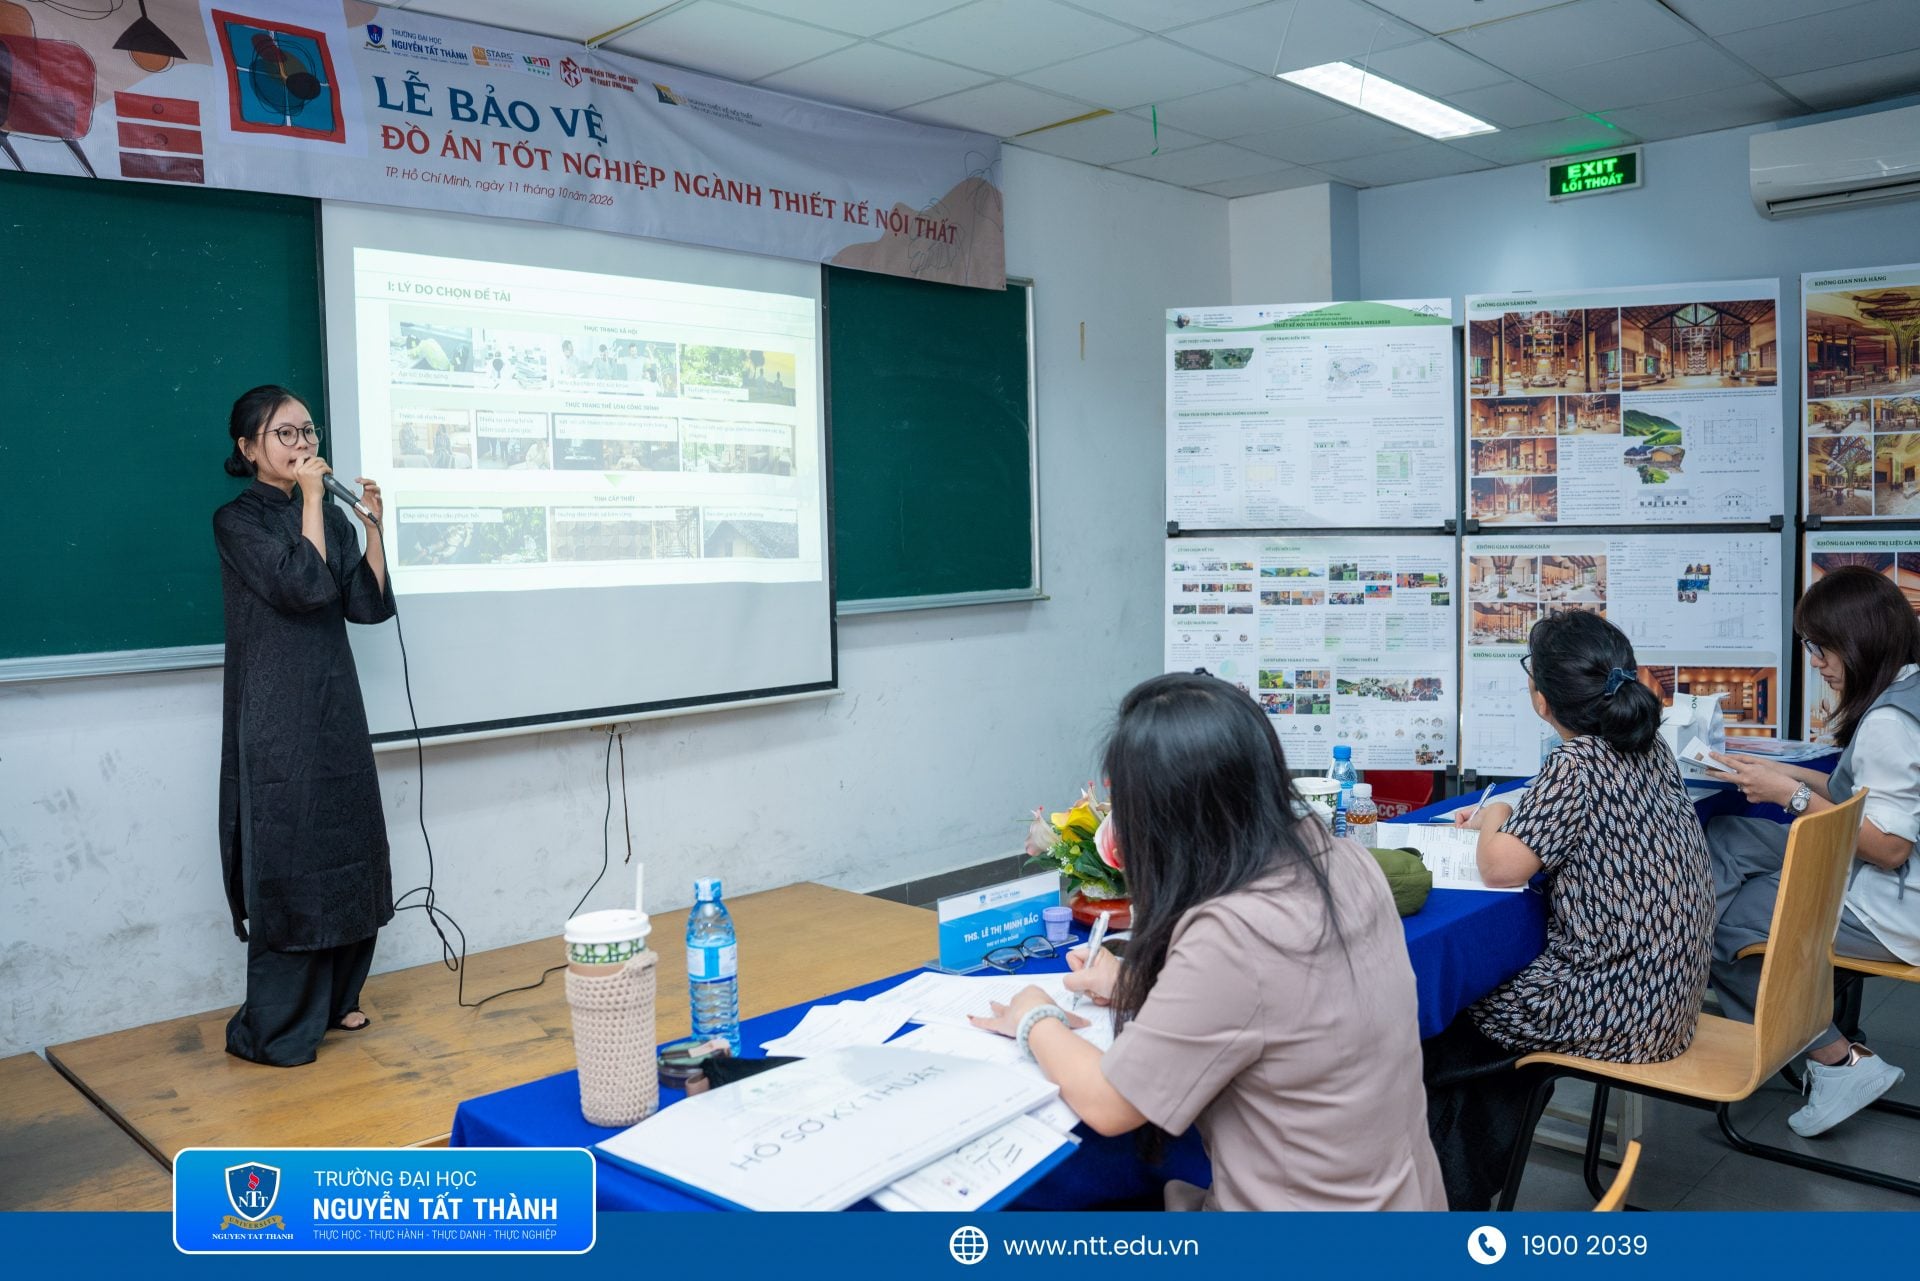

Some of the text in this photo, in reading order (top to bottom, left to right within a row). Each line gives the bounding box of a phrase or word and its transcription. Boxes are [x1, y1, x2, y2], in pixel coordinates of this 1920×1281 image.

[391, 39, 423, 53] NGUYỄN
[425, 44, 439, 56] TẤT
[440, 48, 468, 60] THÀNH
[429, 37, 442, 45] HỌC
[371, 70, 608, 147] LỄ BẢO VỆ
[1567, 158, 1618, 179] EXIT
[380, 121, 957, 245] ĐỒ ÁN TỐT NGHIỆP NGÀNH THIẾT KẾ NỘI THẤT
[386, 166, 399, 179] TP.
[402, 167, 418, 181] Hồ
[421, 171, 441, 185] Chí
[443, 174, 471, 188] Minh,
[476, 179, 505, 194] ngày
[509, 181, 520, 193] 11
[523, 183, 555, 200] tháng
[1562, 172, 1624, 193] LỐI THOÁT
[398, 280, 411, 293] LÝ
[415, 284, 433, 295] DO
[436, 286, 471, 300] CHỌN
[492, 291, 511, 302] TÀI
[964, 912, 1039, 943] THS. LÊ THỊ MINH BẮC
